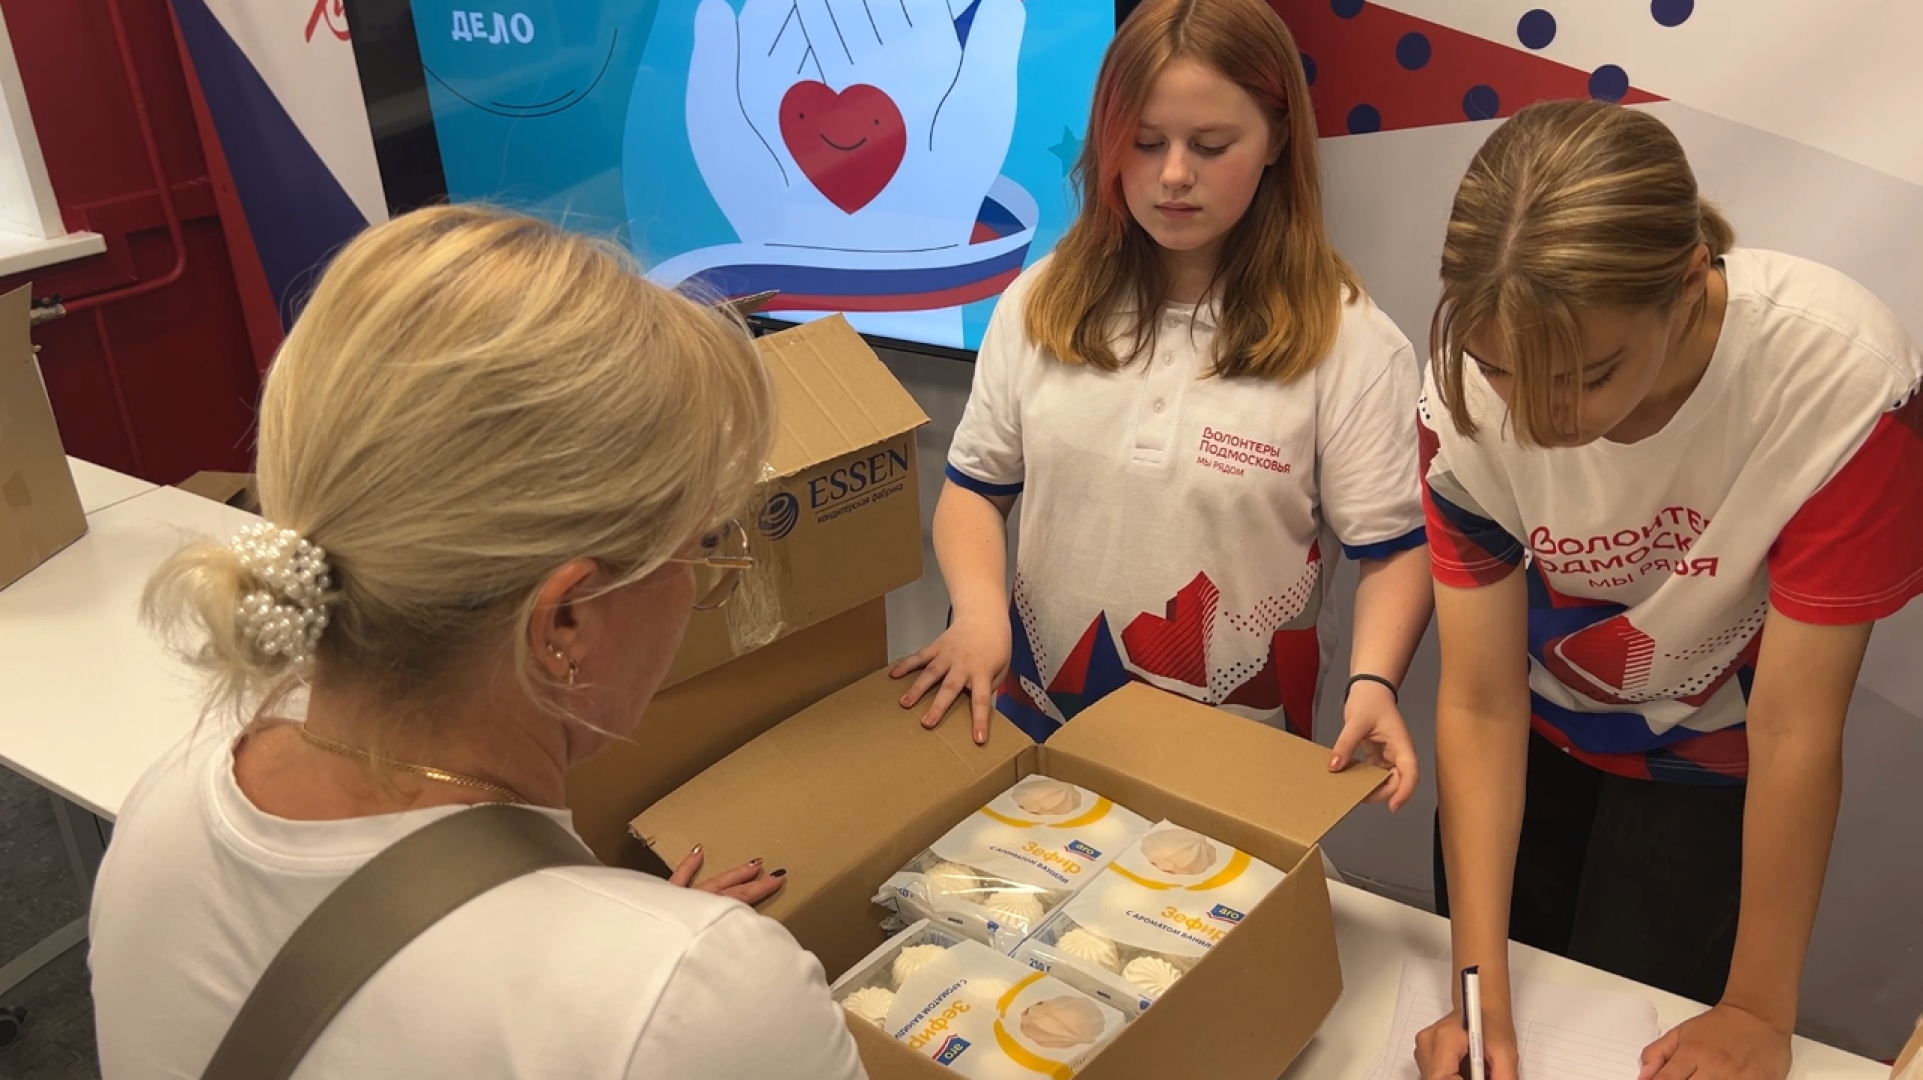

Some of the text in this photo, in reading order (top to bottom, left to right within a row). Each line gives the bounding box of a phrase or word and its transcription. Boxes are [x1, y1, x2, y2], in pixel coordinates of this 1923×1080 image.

[451, 9, 534, 44] ДЕЛО
[807, 442, 909, 509] ESSEN
[1196, 456, 1245, 477] МЫ РЯДОМ
[871, 483, 904, 502] фабрика
[1529, 505, 1711, 556] ВОЛОНТЕ
[1588, 573, 1635, 589] МЫ
[1021, 841, 1082, 875] Зефир
[1218, 906, 1240, 919] aro
[1132, 913, 1181, 936] АРОМАТОМ
[908, 1000, 971, 1052] Зефир
[944, 1043, 964, 1060] aro
